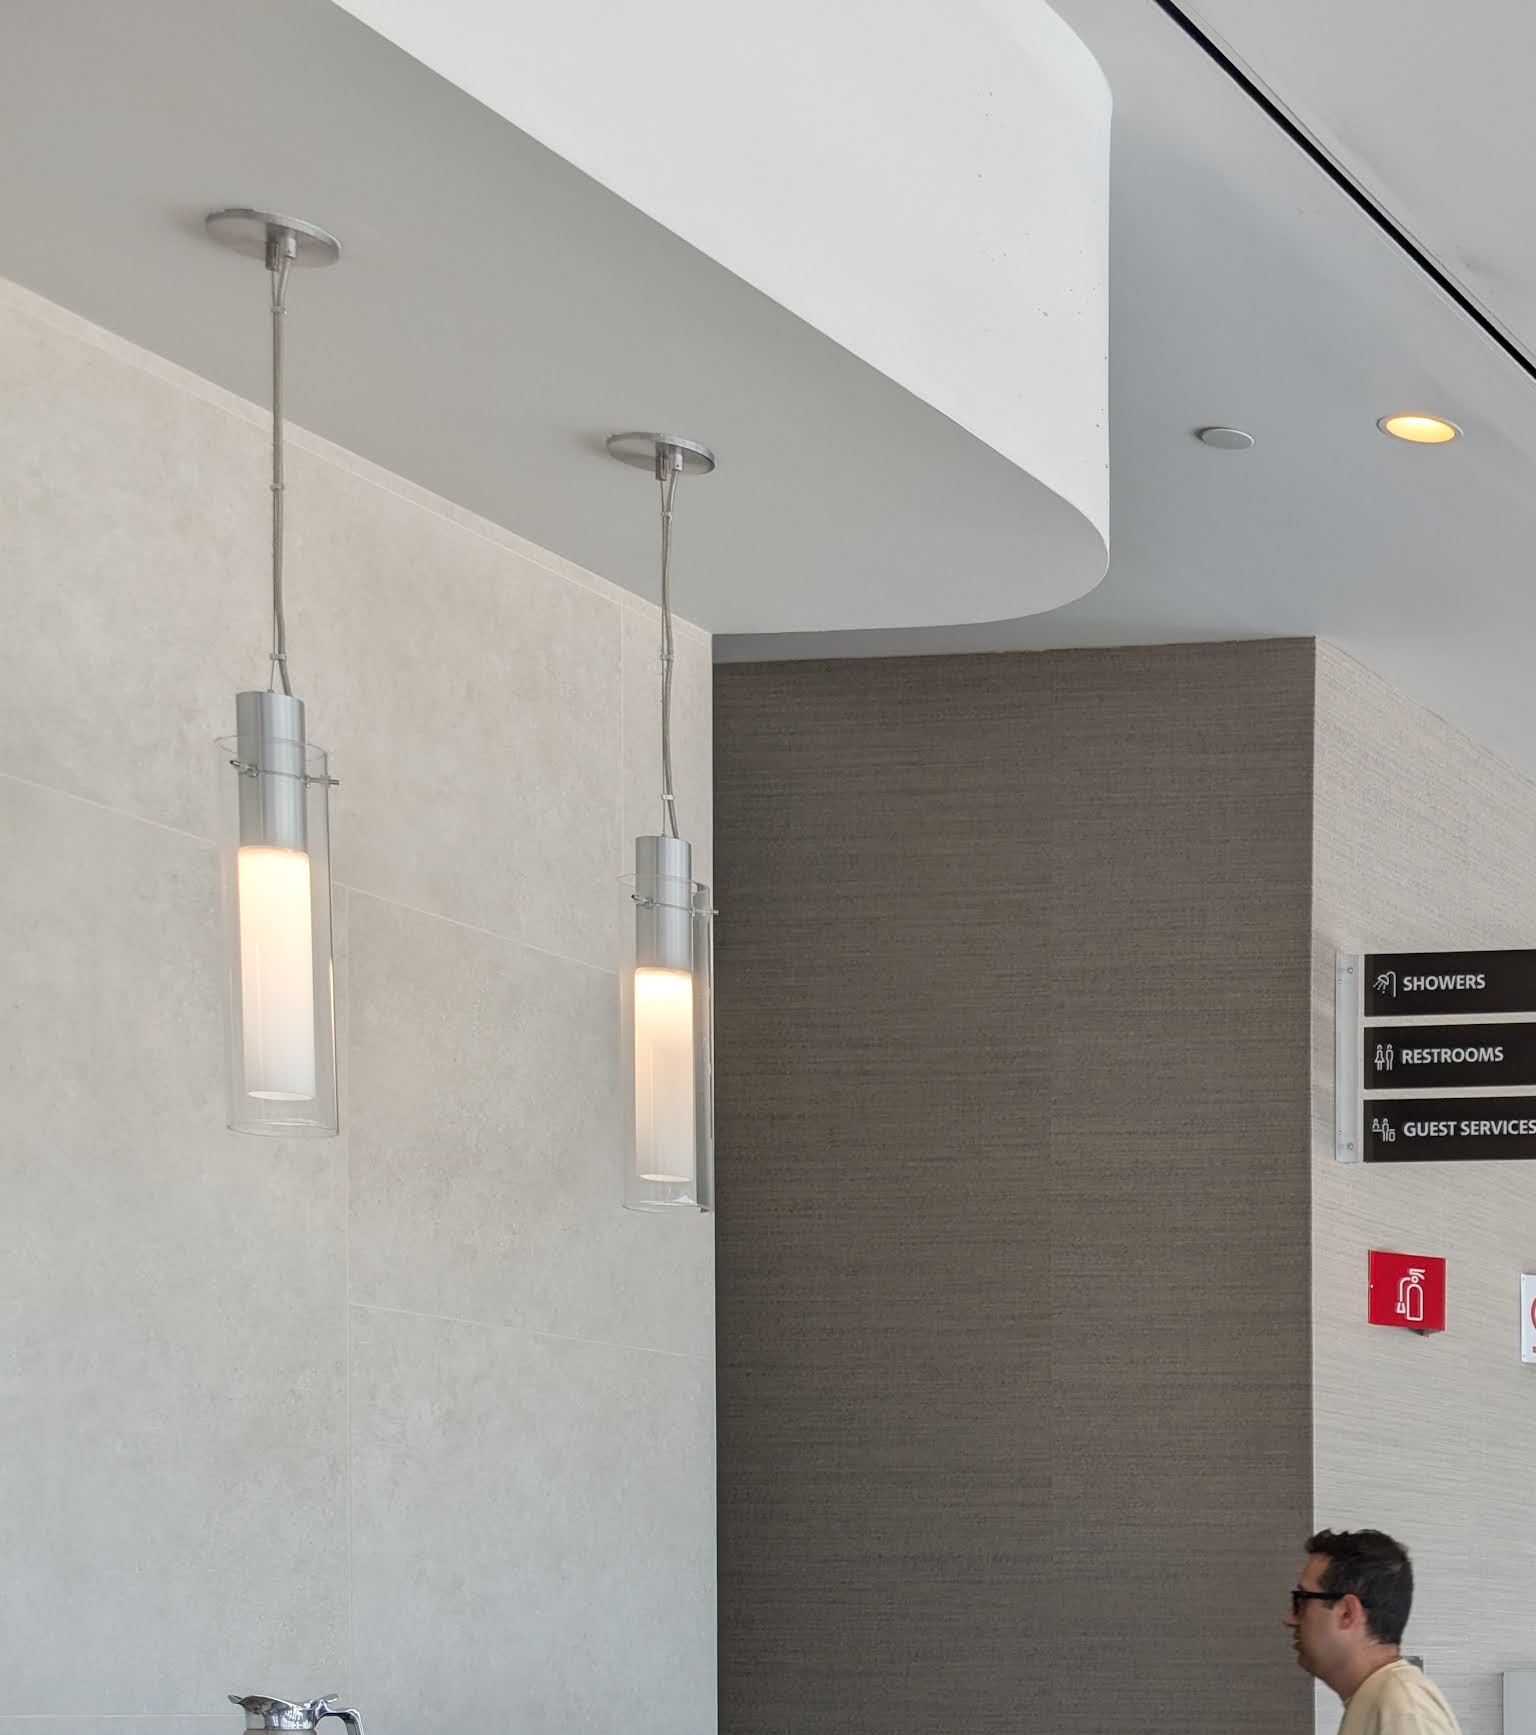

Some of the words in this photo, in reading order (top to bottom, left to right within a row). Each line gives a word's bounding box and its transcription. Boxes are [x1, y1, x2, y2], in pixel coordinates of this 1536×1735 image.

[1403, 974, 1486, 992] SHOWERS
[1402, 1046, 1504, 1064] RESTROOMS
[1403, 1121, 1457, 1137] GUEST
